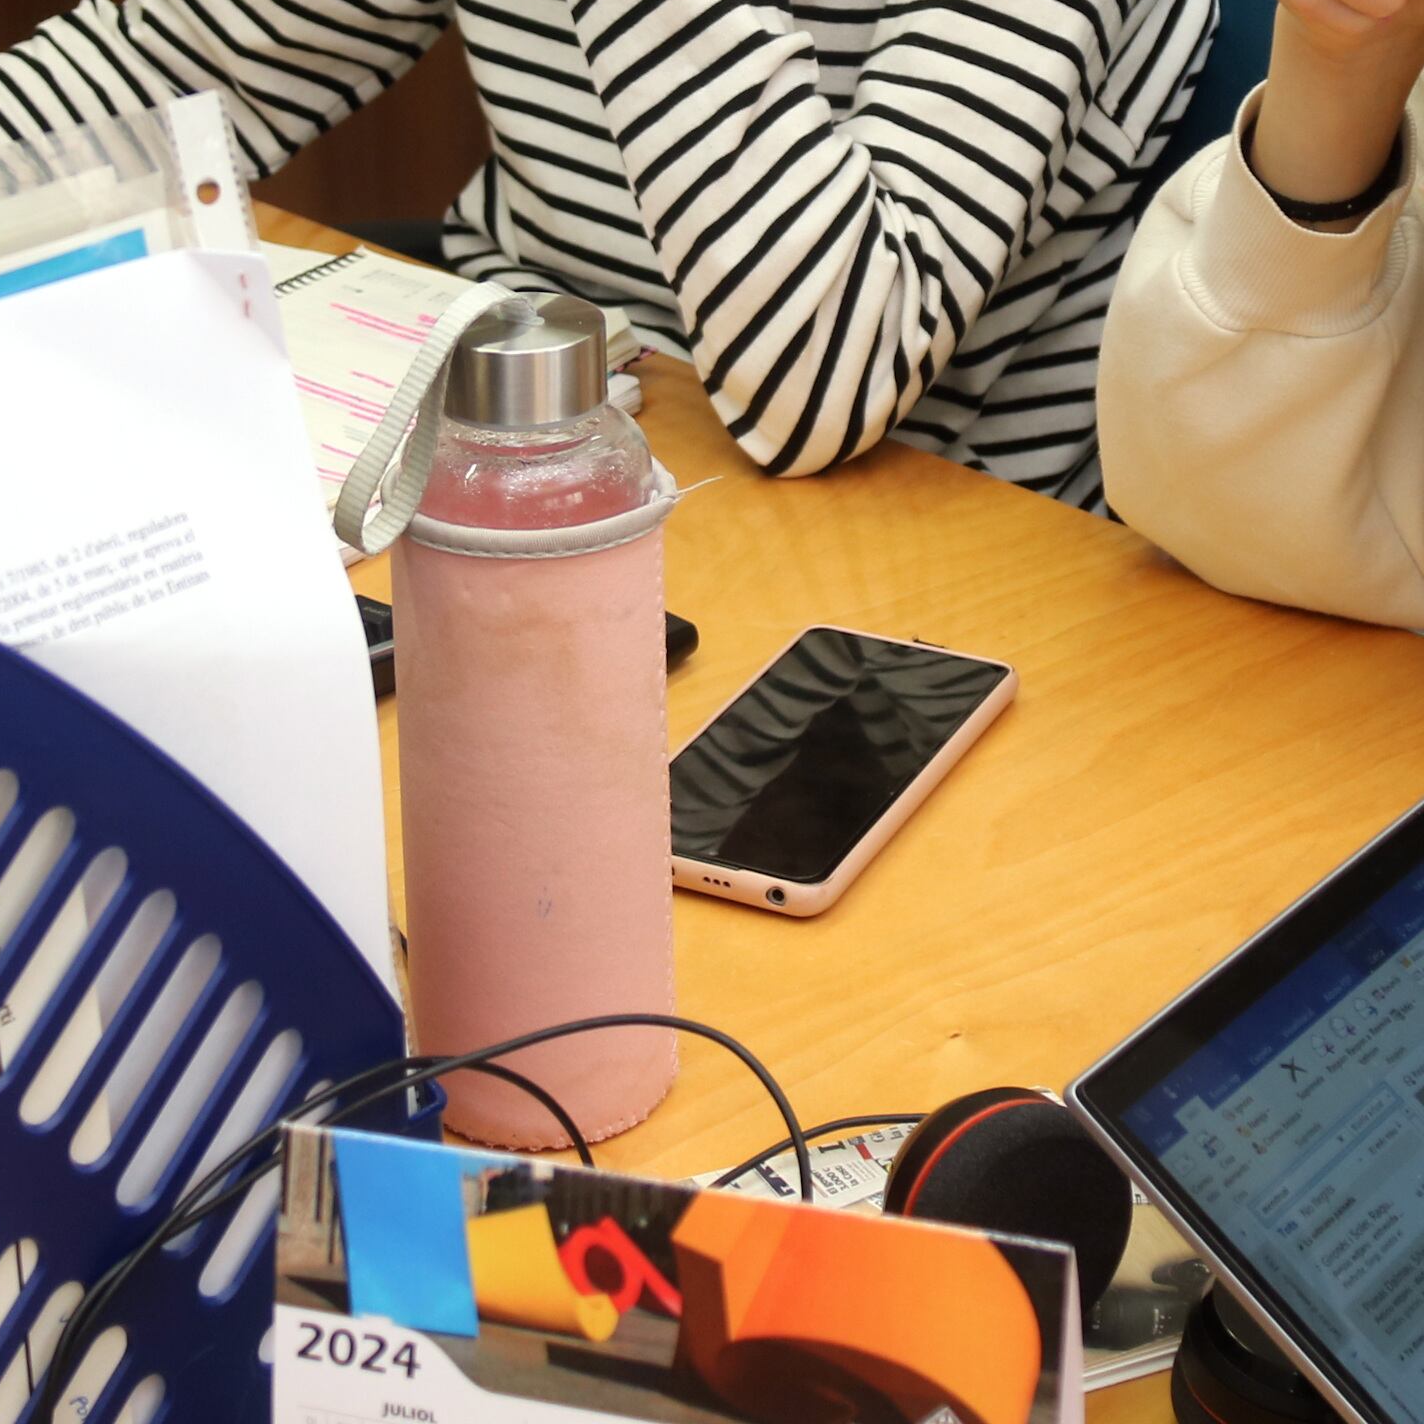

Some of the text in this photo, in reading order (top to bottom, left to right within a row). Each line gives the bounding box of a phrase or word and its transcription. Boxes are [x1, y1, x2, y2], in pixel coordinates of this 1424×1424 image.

[127, 511, 190, 544] reguladora
[296, 1321, 423, 1379] 2024
[381, 1401, 438, 1424] JULIOL
